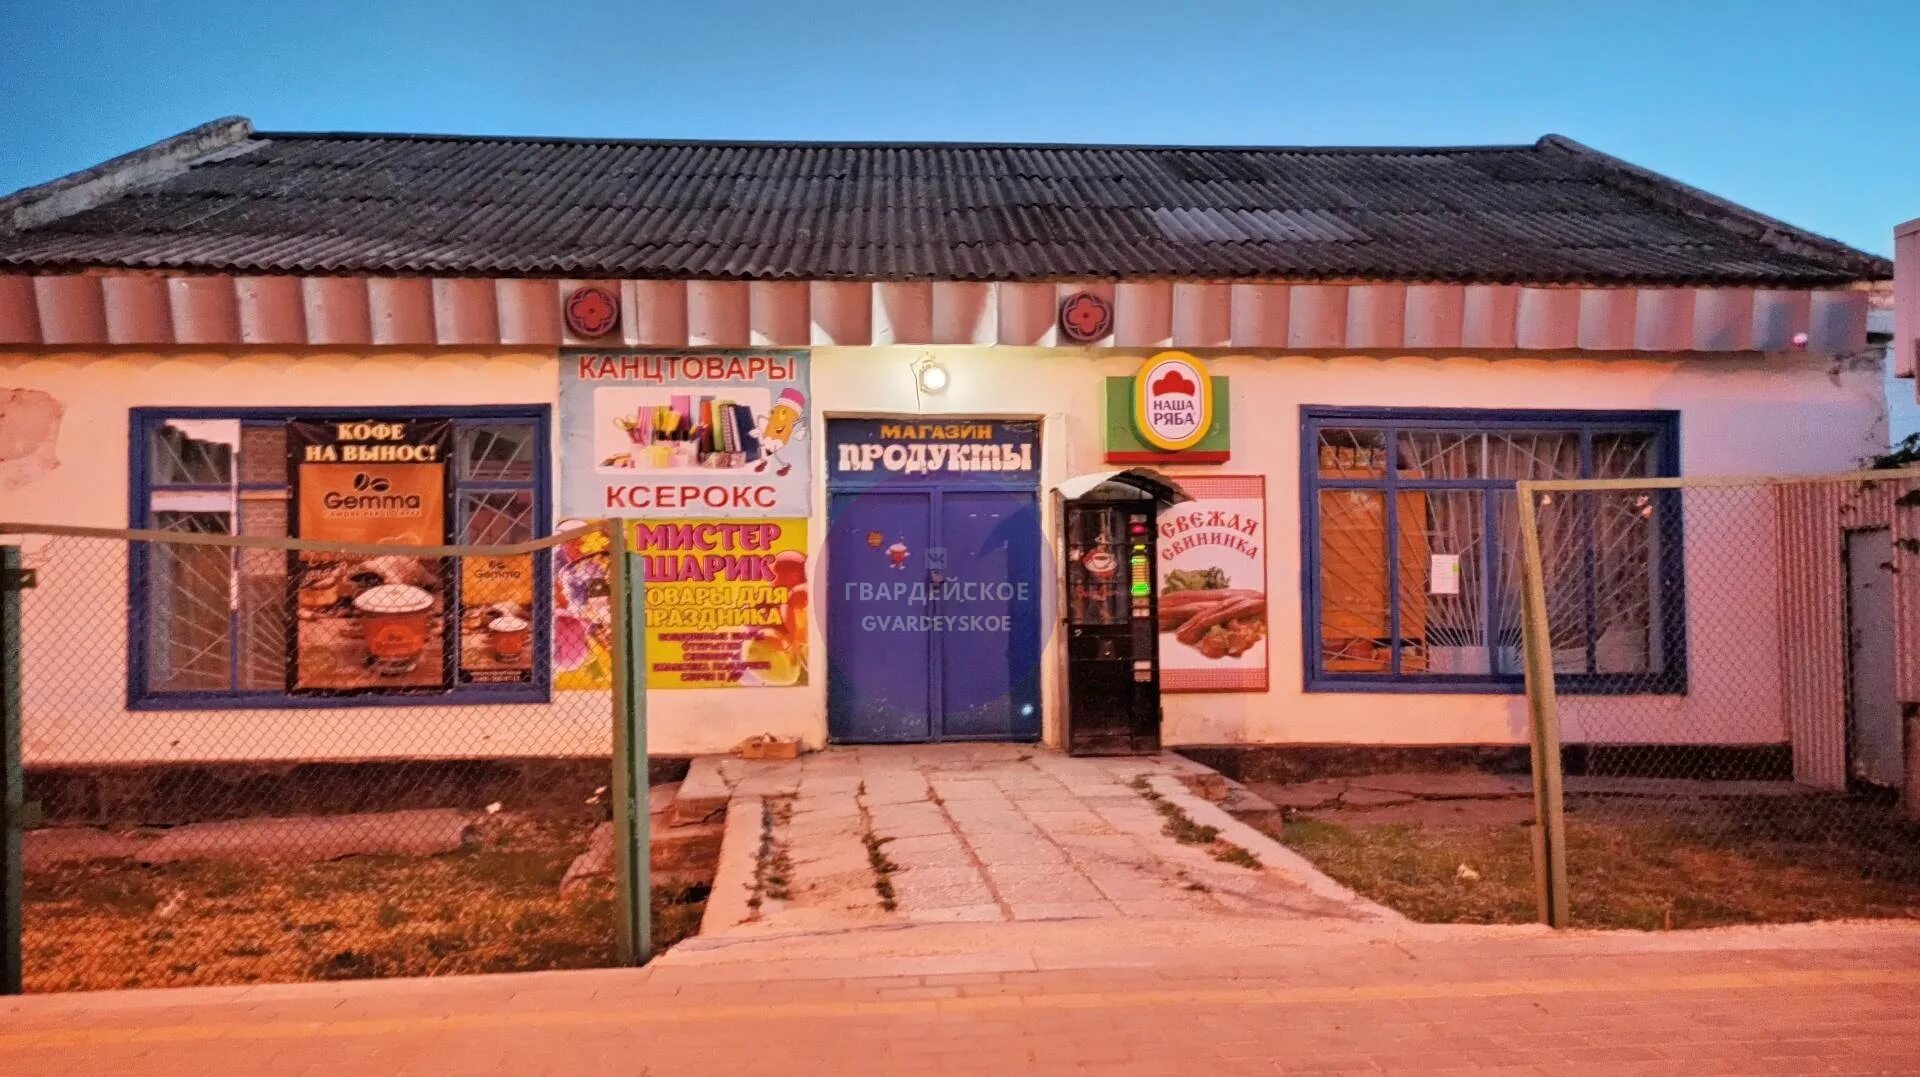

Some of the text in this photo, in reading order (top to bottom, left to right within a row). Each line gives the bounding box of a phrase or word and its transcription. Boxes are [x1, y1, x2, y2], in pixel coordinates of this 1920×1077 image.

[578, 355, 796, 384] КАНЦТОВАРЫ
[1153, 400, 1194, 411] НАША
[1153, 412, 1195, 426] РЯБА
[337, 423, 406, 441] КОФЕ
[880, 425, 992, 440] МАГАЗИН
[305, 443, 438, 462] НА ВЫНОС!
[838, 443, 1032, 475] ПРОДУКТЫ
[323, 491, 421, 510] Gemma
[606, 486, 777, 508] КСЕРОКС
[1160, 509, 1258, 539] СВЕЖАЯ
[635, 523, 782, 551] МИСТЕР
[1161, 531, 1258, 560] СВИНИНКА
[474, 570, 521, 579] Gemma
[643, 554, 777, 582] ШАРИК
[645, 586, 789, 608] ОВАРЫ ДЛЯ
